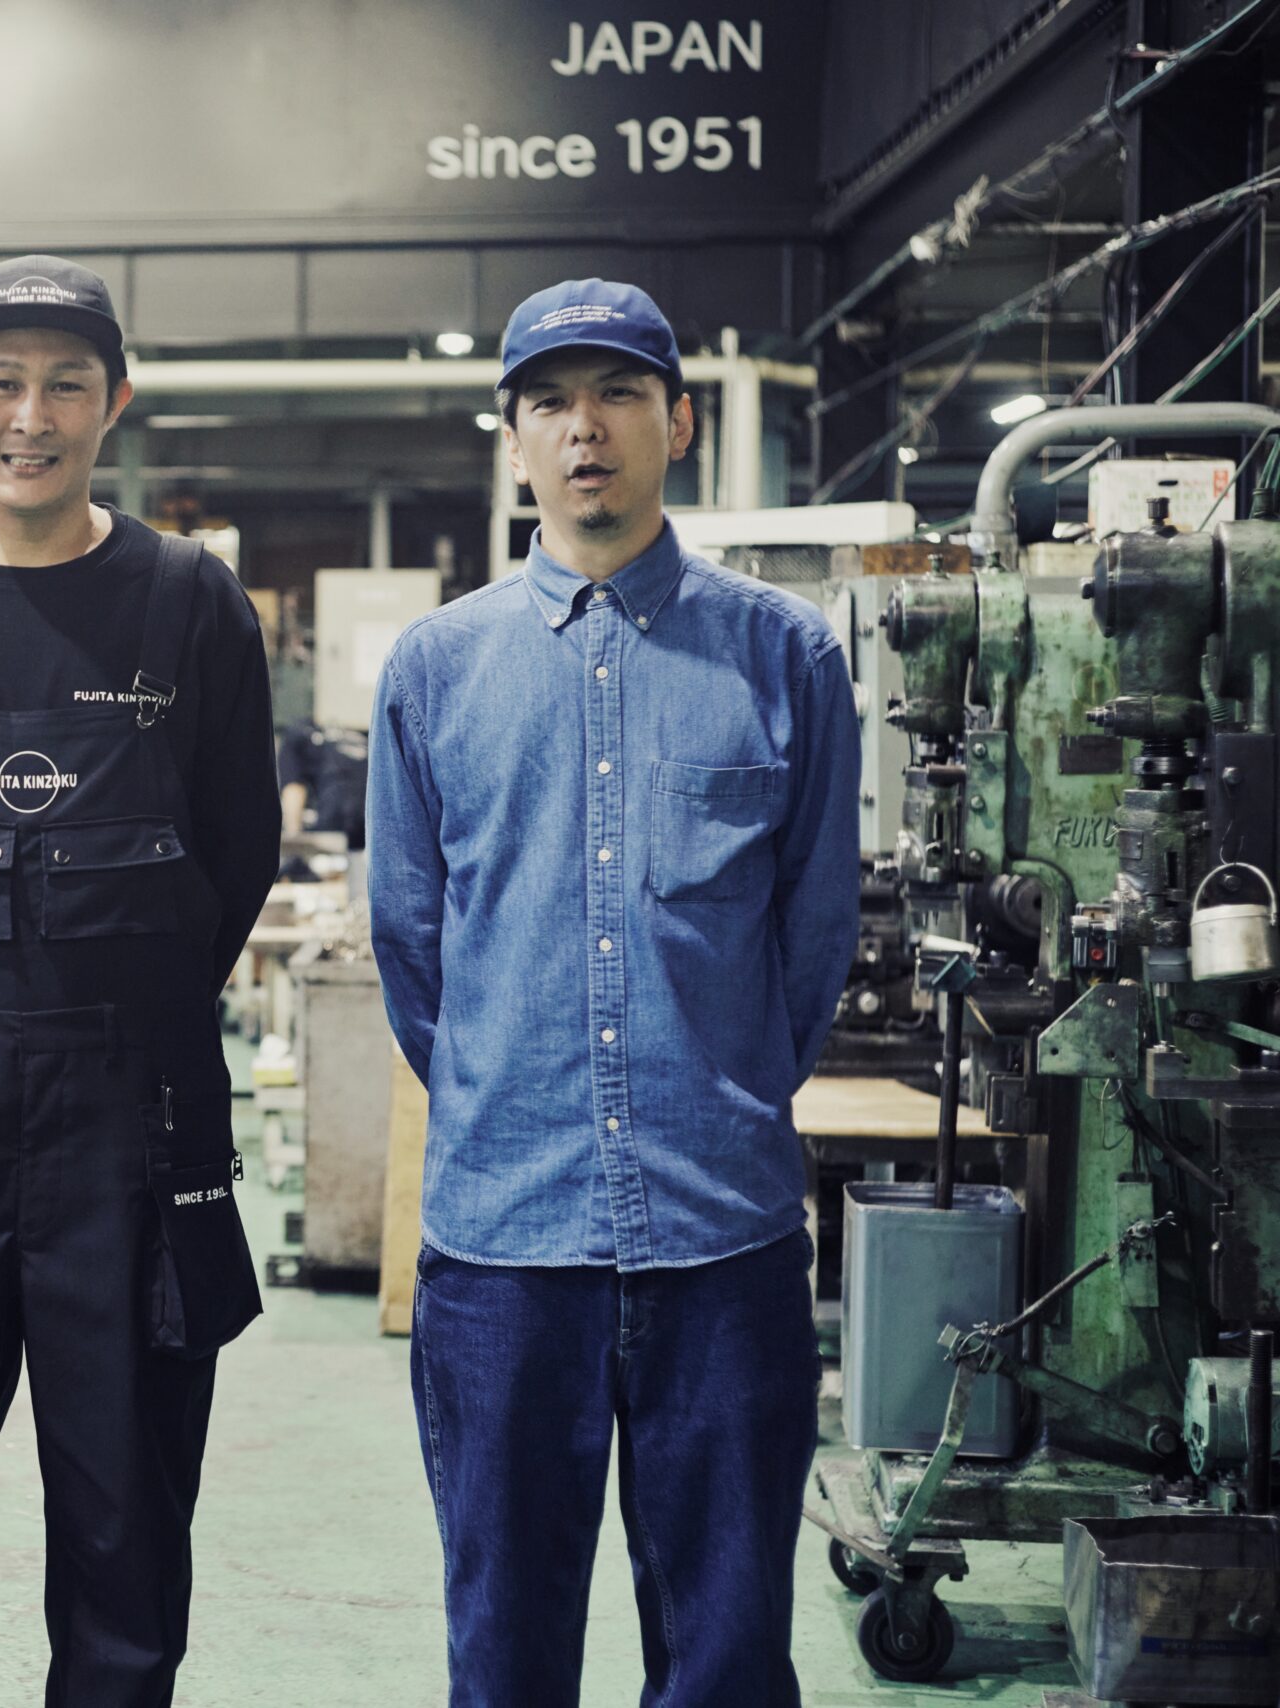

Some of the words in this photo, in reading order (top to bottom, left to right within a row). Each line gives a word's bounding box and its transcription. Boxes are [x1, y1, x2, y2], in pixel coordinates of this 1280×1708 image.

[550, 19, 763, 77] JAPAN
[426, 122, 597, 180] since
[615, 115, 763, 174] 1951
[31, 286, 77, 300] KINZOKU
[73, 691, 115, 702] FUJITA
[23, 773, 78, 789] KINZOKU
[174, 1191, 203, 1205] SINCE
